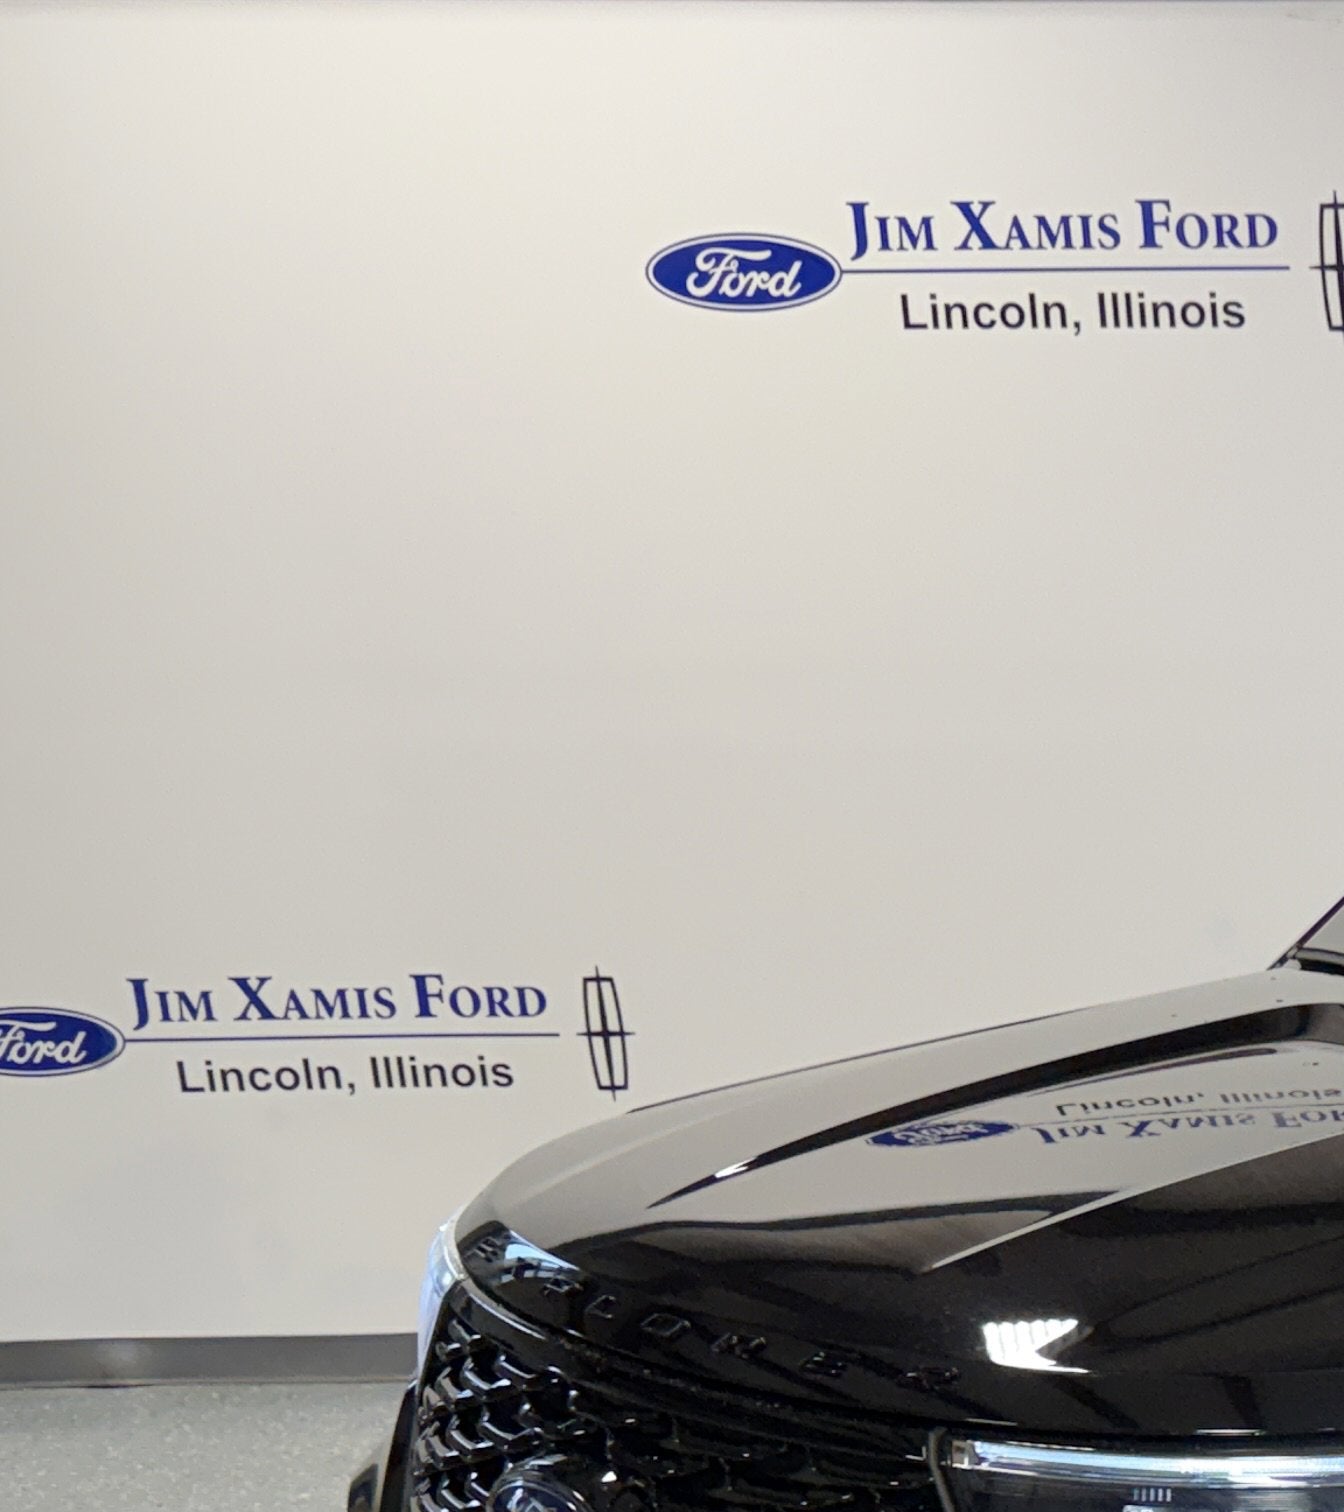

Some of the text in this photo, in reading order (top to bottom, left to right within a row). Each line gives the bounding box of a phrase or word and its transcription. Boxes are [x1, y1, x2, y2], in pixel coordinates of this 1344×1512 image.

[845, 198, 1279, 260] JIM XAMIS FORD
[685, 248, 804, 299] Ford
[900, 291, 1246, 337] Lincoln, Illinois
[126, 973, 548, 1031] JIM XAMIS FORD
[176, 1055, 515, 1096] Lincoln, Illinois
